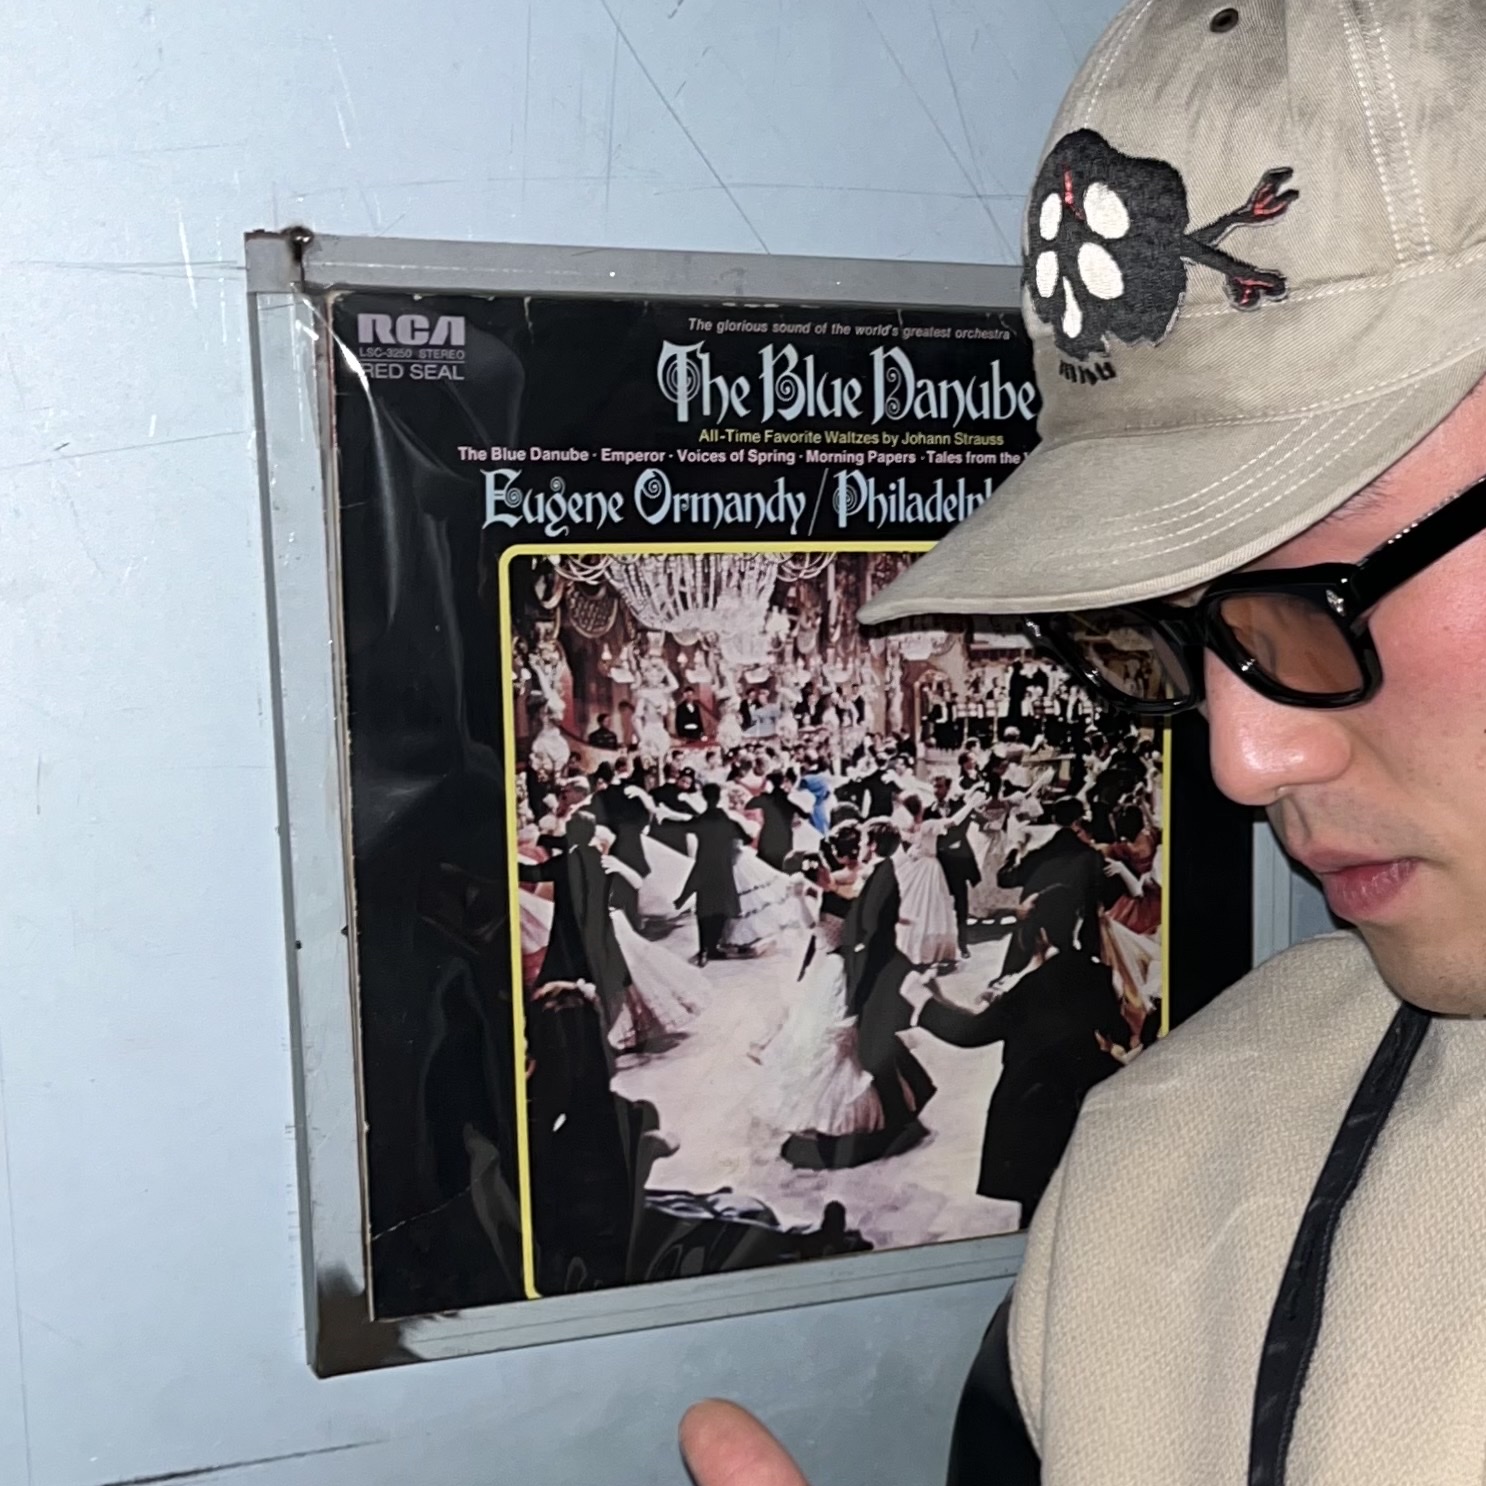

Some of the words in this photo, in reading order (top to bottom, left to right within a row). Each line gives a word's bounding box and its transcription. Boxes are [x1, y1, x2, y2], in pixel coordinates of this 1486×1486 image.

[357, 313, 465, 346] RCA
[688, 317, 712, 331] The
[716, 319, 768, 334] glorious
[772, 321, 811, 334] sound
[815, 322, 828, 334] of
[831, 323, 851, 335] the
[855, 324, 899, 337] world's
[903, 327, 951, 340] greatest
[955, 328, 1010, 340] orchestra
[418, 348, 465, 360] STEREO
[361, 362, 404, 379] RED
[409, 363, 465, 380] SEAL
[657, 340, 752, 424] The
[758, 343, 864, 424] Blue
[869, 345, 1038, 428] Danube
[699, 428, 761, 443] All-Time
[764, 430, 822, 444] Favorite
[824, 431, 880, 445] Waltzes
[882, 432, 900, 447] by
[901, 432, 951, 445] Johann
[954, 432, 1005, 446] Strauss
[457, 446, 487, 461] The
[490, 447, 526, 461] Blue
[530, 447, 589, 461] Danube
[600, 448, 666, 465] Emperor
[677, 449, 726, 463] Voices
[729, 449, 745, 463] of
[747, 449, 796, 465] Spring
[805, 450, 865, 466] Morning
[868, 450, 917, 466] Papers
[926, 450, 963, 464] Tales
[966, 451, 997, 464] from
[1000, 452, 1021, 465] the
[480, 468, 624, 537] Eugene
[634, 468, 806, 535] Ormandy
